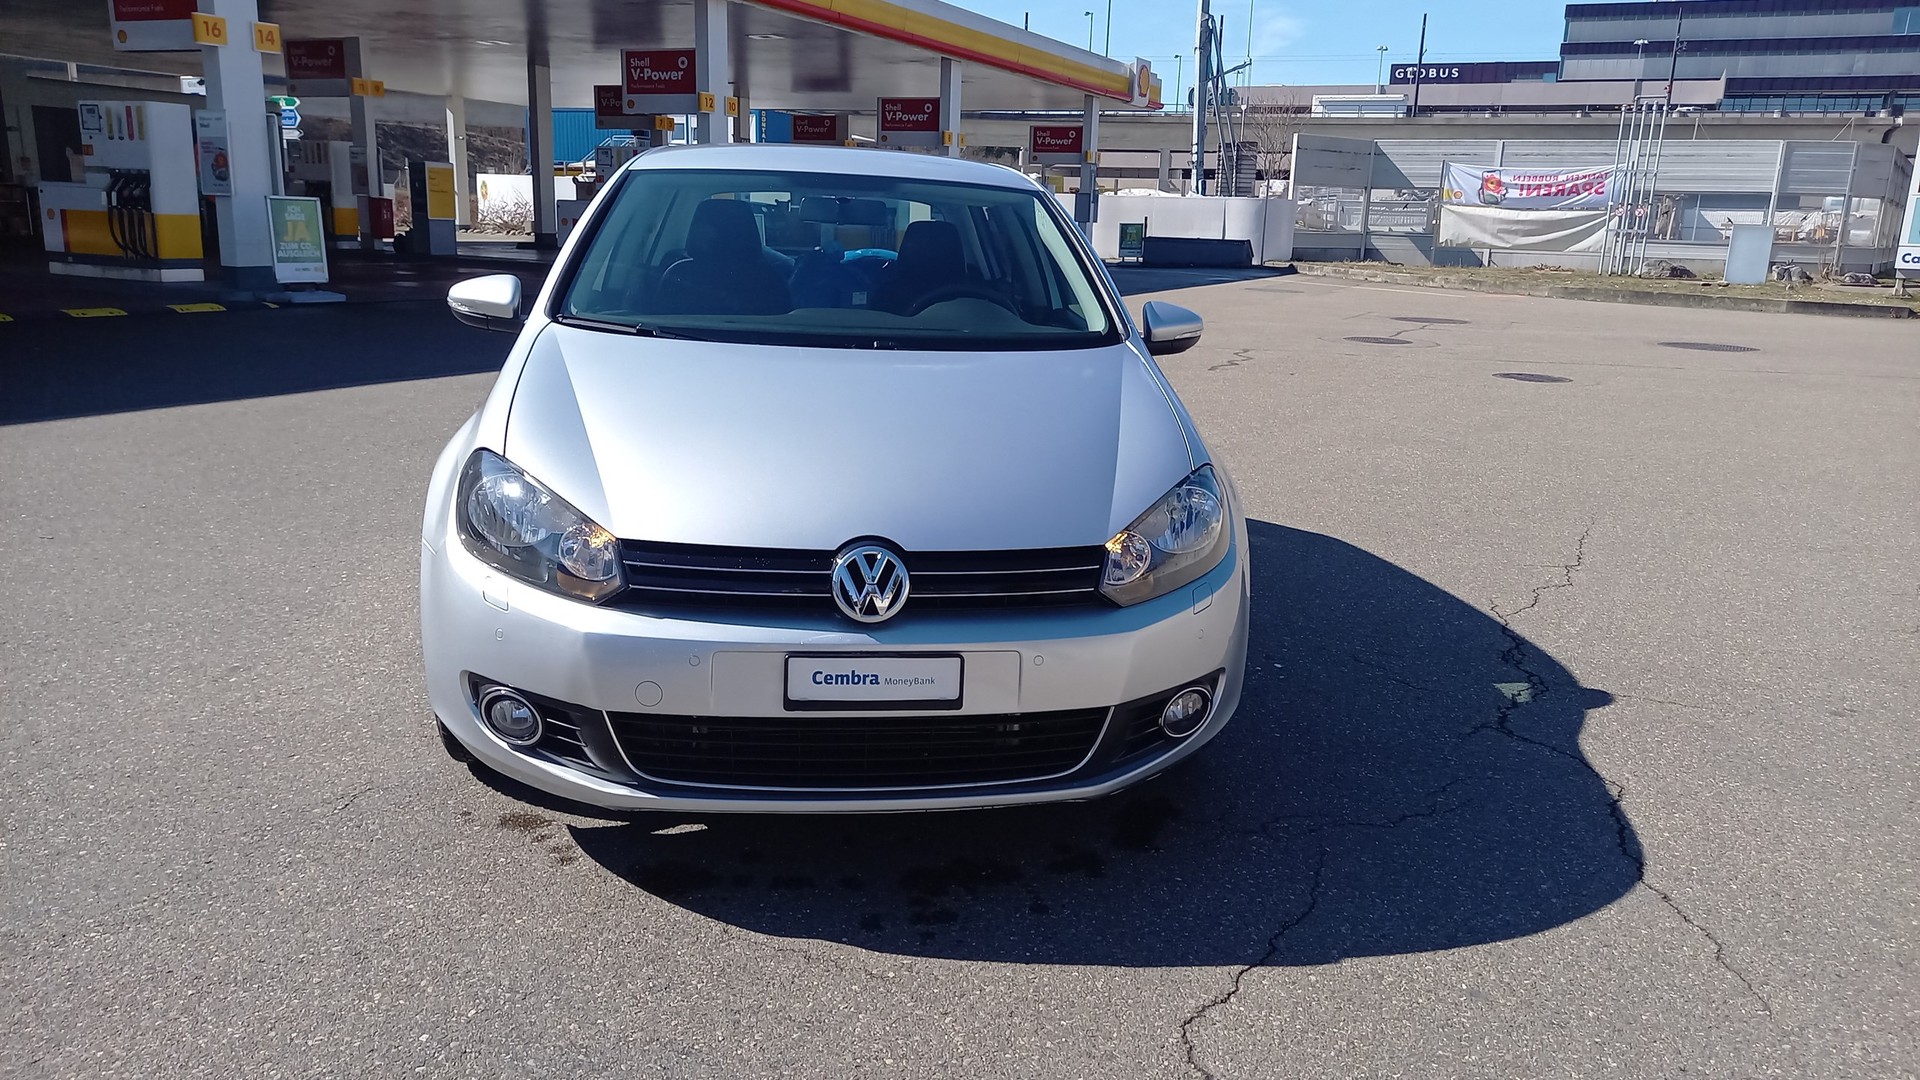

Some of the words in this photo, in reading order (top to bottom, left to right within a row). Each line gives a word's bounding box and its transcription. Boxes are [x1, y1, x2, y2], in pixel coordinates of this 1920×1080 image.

[203, 21, 222, 38] 16
[258, 29, 275, 45] 14
[291, 56, 332, 66] V-Power
[630, 58, 650, 67] Shell
[631, 68, 683, 80] V-Power
[1395, 68, 1459, 78] GLOBUS
[601, 99, 623, 107] V-Po
[705, 97, 713, 108] 12
[728, 102, 736, 111] 10
[885, 103, 901, 111] Shell
[885, 111, 928, 121] V-Power
[1036, 137, 1073, 145] V-Power
[283, 221, 310, 241] JA
[812, 670, 880, 685] Cembra
[884, 677, 936, 687] MoneyBank
